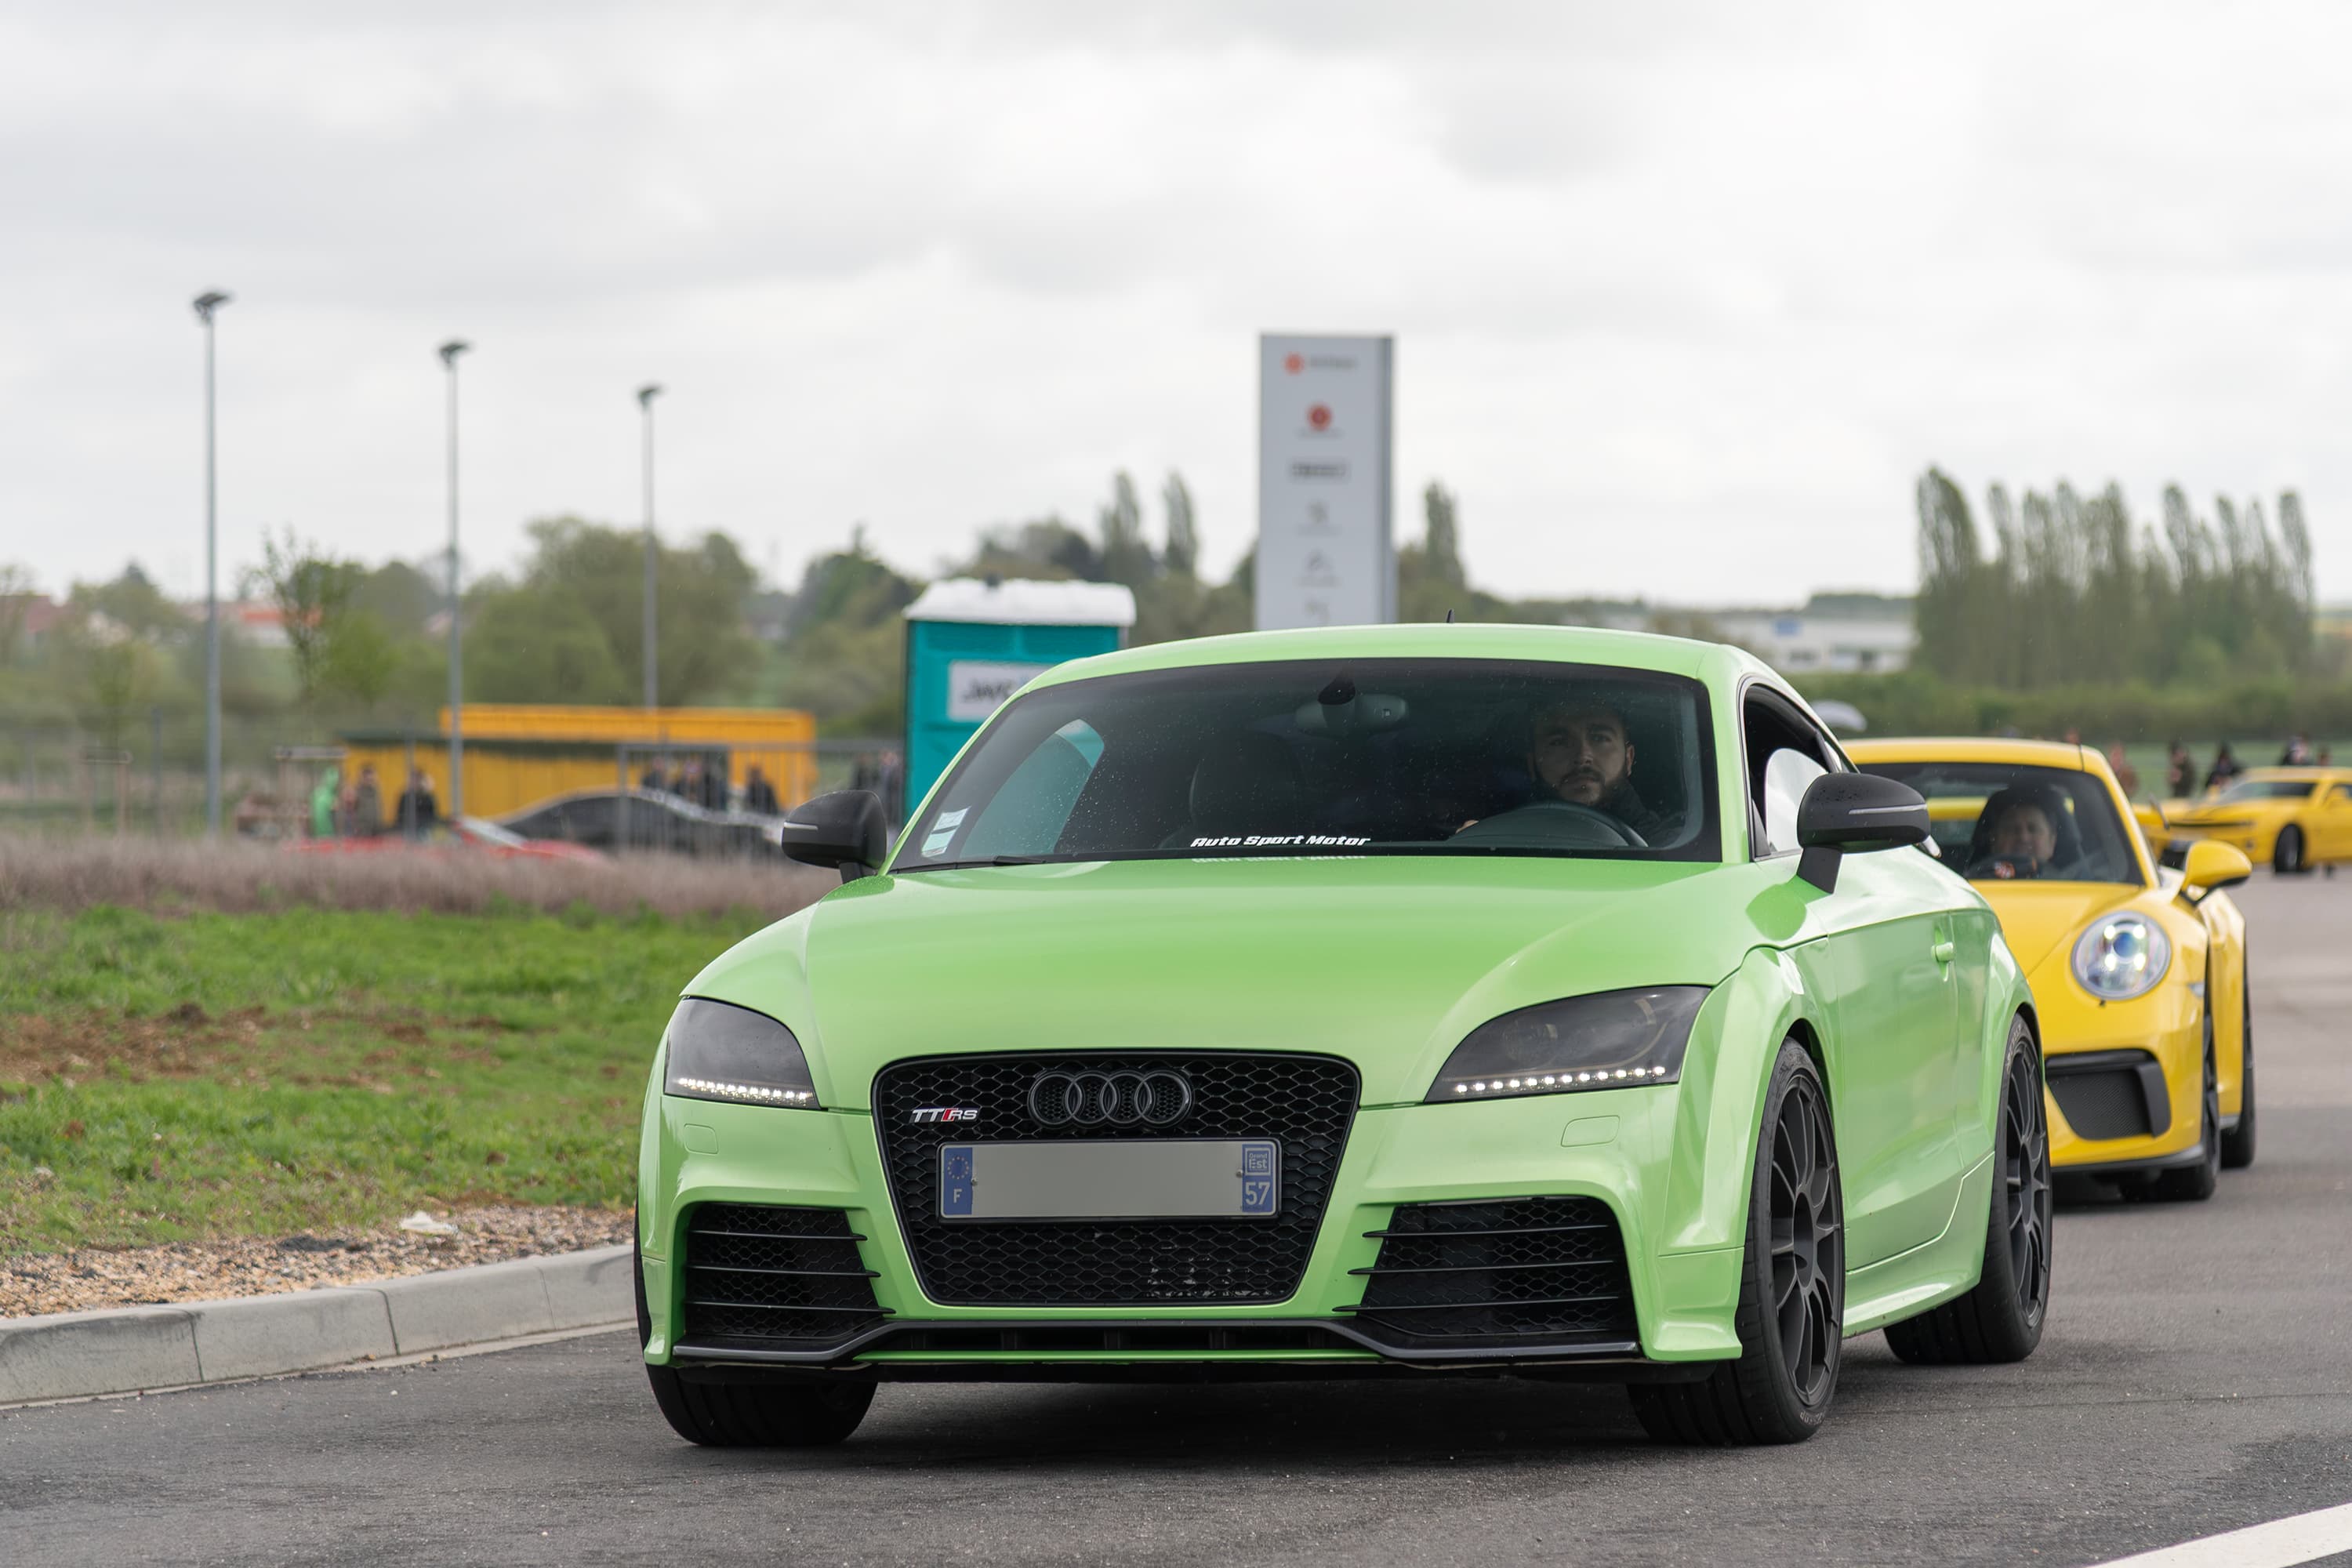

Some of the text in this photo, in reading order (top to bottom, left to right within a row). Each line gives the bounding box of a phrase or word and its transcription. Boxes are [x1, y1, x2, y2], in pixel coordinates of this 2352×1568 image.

[1190, 835, 1370, 848] Auto Sport Motor
[1249, 1159, 1268, 1169] Est
[953, 1189, 963, 1203] F
[1245, 1181, 1270, 1205] 57
